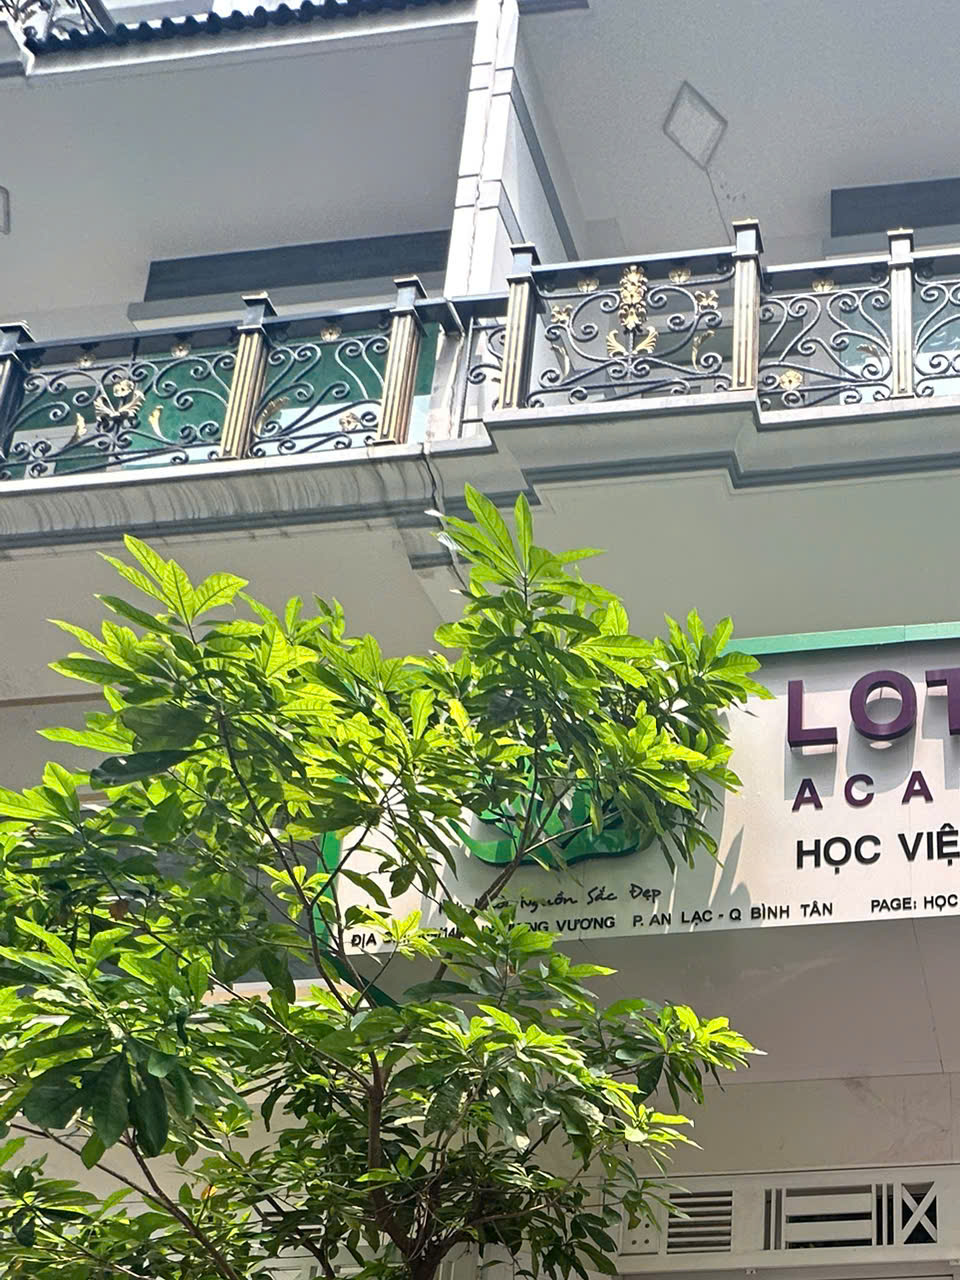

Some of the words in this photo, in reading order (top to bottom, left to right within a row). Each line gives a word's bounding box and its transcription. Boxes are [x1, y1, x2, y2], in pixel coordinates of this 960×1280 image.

[796, 835, 881, 875] HỌC
[629, 883, 662, 905] Đẹp
[870, 896, 916, 913] PAGE:
[923, 893, 958, 912] HỌC
[555, 915, 615, 932] VƯƠNG
[681, 910, 713, 926] LẠC
[751, 905, 790, 920] BÌNH
[800, 902, 833, 917] TÂN
